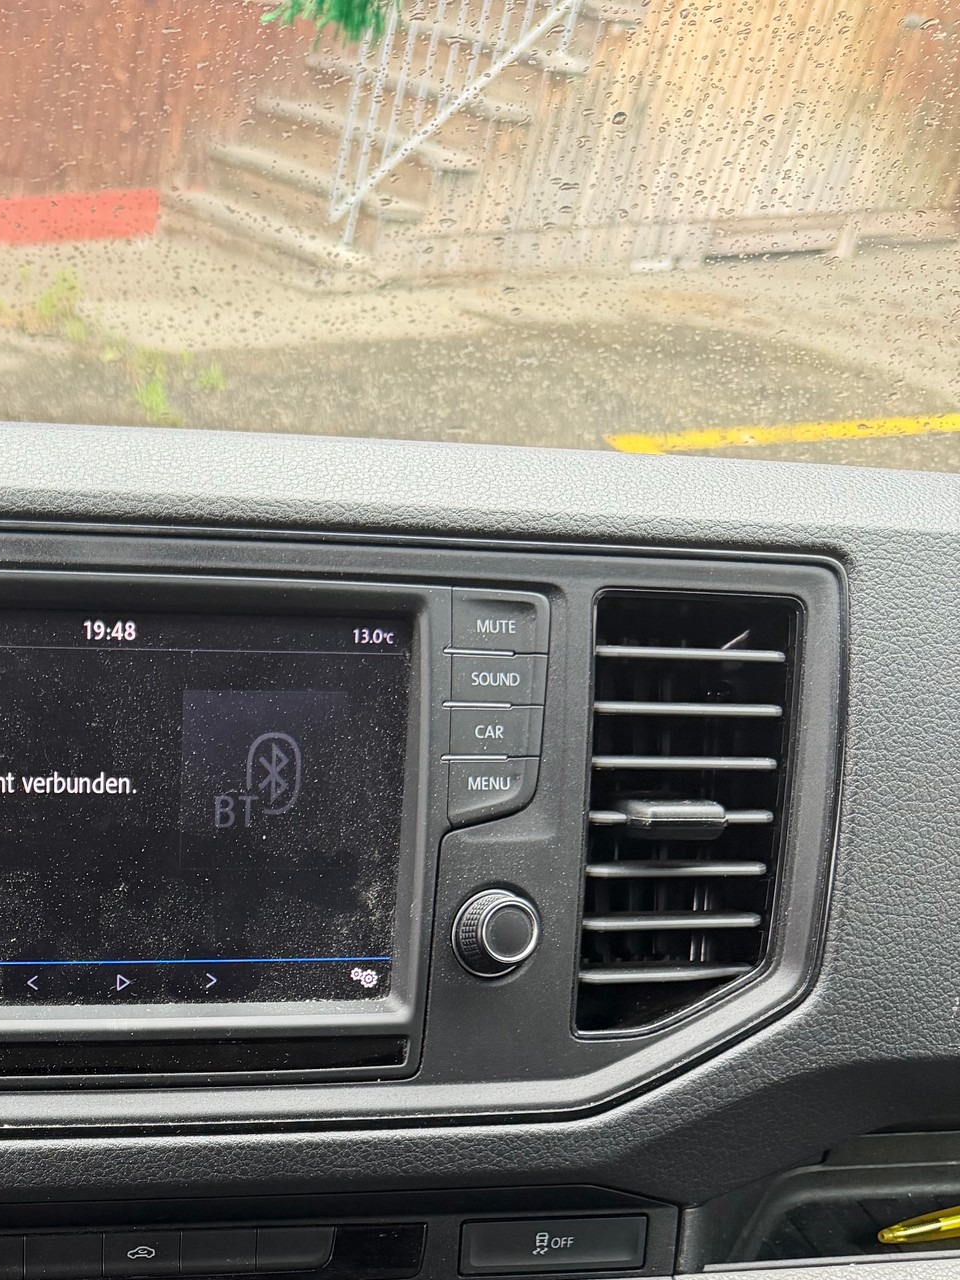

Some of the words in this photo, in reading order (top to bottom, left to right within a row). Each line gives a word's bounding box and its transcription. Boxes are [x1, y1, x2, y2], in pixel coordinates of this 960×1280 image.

[83, 621, 137, 641] 19:48
[476, 619, 516, 635] MUTE
[471, 671, 521, 687] SOUND
[474, 724, 504, 740] CAR
[21, 771, 137, 794] verbunden.
[467, 776, 511, 791] MENU
[214, 795, 260, 828] BT
[550, 1235, 575, 1249] OFF
